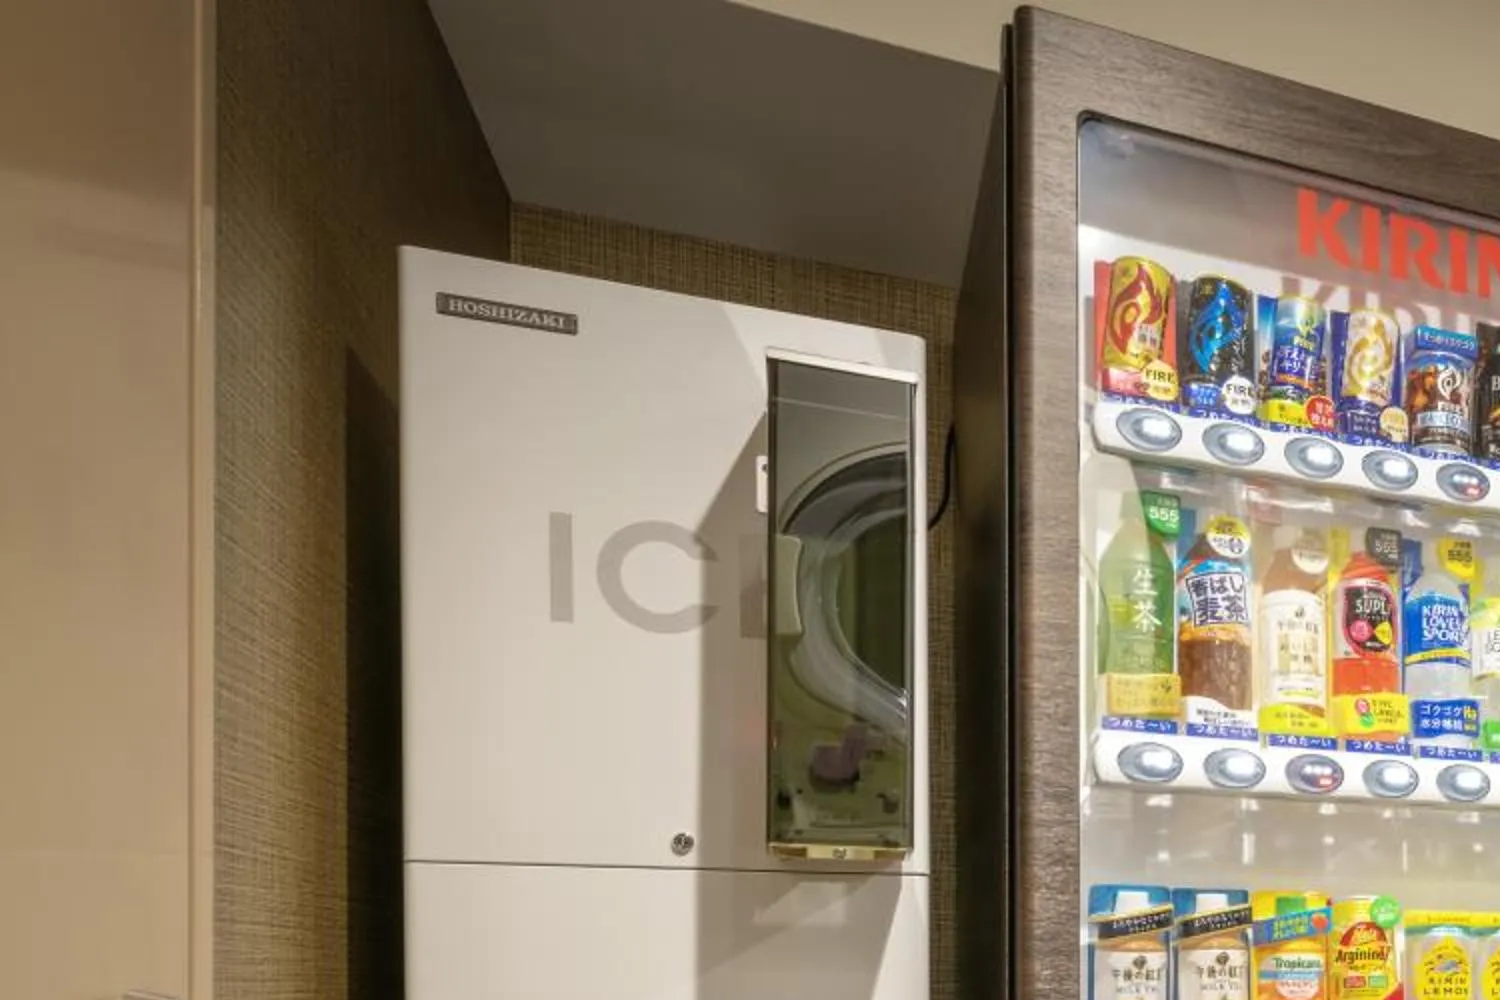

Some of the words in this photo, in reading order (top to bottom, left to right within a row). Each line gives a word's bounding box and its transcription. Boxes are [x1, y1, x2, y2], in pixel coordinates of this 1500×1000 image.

[449, 298, 567, 329] HOSHIZAKI
[549, 511, 768, 638] IC
[1132, 567, 1162, 632] 生茶
